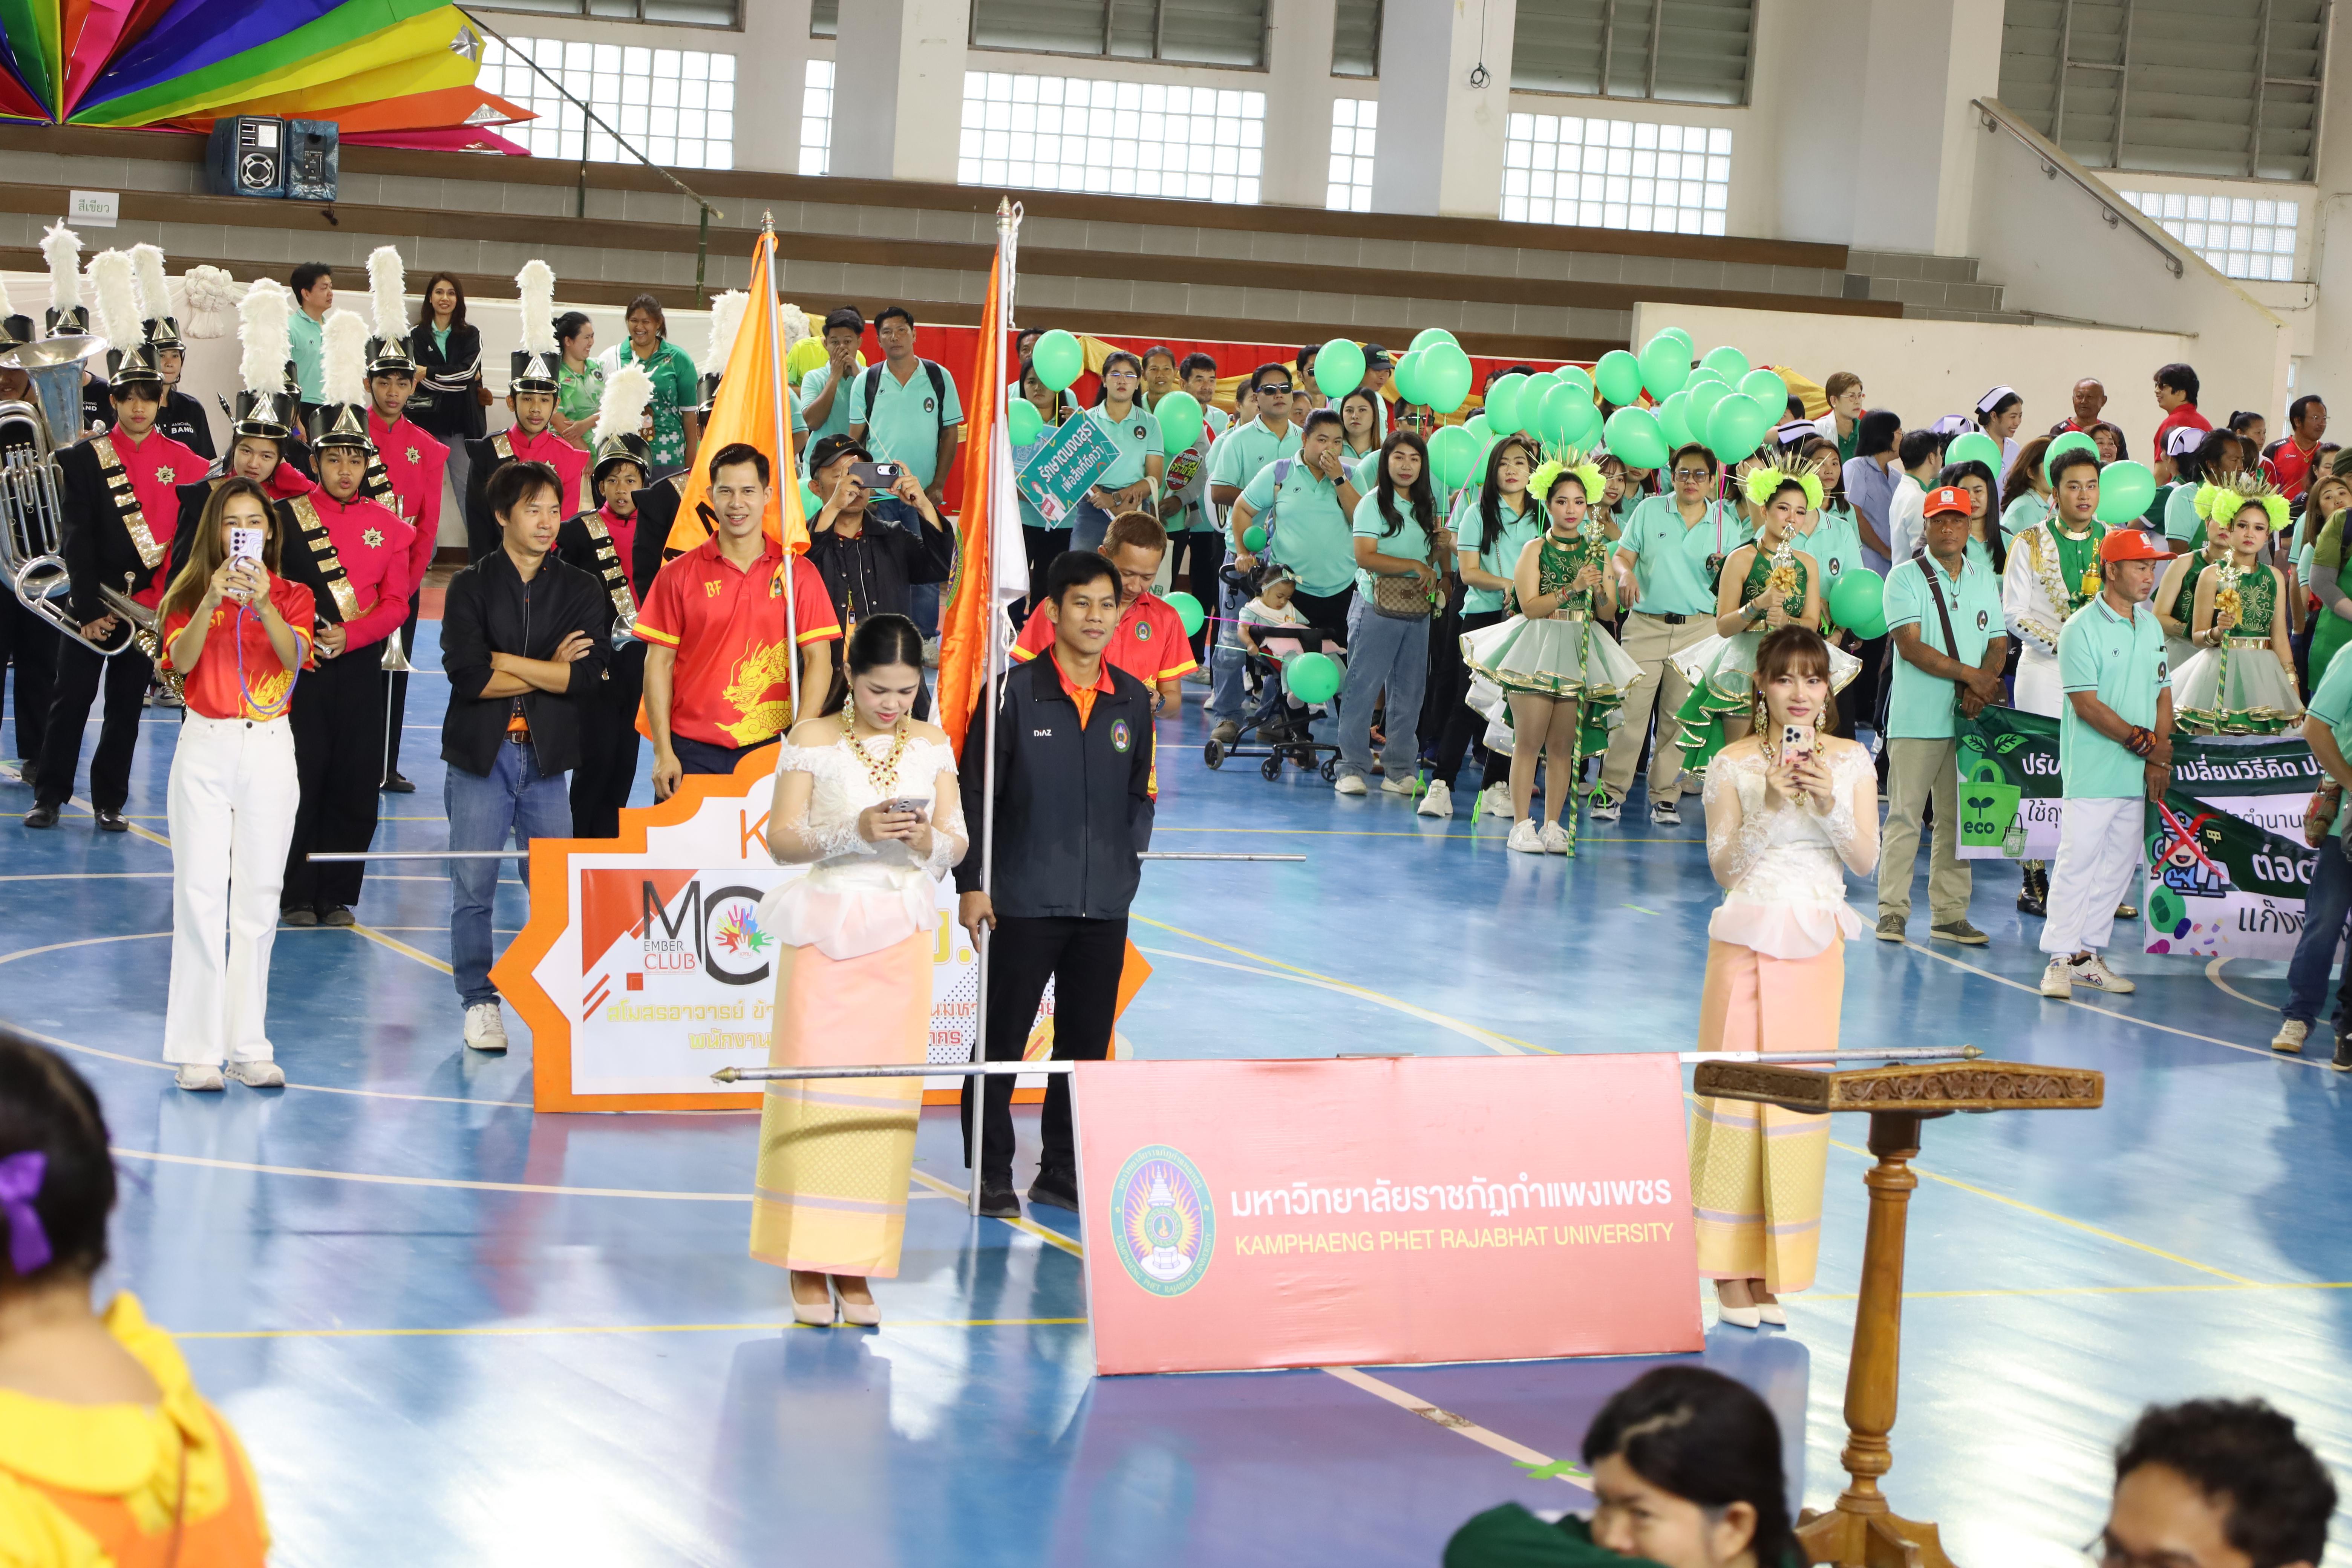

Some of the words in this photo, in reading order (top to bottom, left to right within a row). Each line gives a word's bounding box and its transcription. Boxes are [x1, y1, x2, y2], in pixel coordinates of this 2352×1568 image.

[78, 199, 109, 213] สีเขียว
[2176, 754, 2299, 781] เปลี่ยนวิธีคิด
[2028, 799, 2063, 829] ใช้ถุ
[1964, 821, 1995, 834] eco
[644, 953, 696, 970] CLUB
[607, 998, 745, 1021] สโมสรอาจารย์
[1231, 1171, 1672, 1217] มหาวิทยาลัยราชภัฏกำแพงเพชร
[1235, 1231, 1374, 1255] KAMPHAENG
[1380, 1230, 1434, 1251] PHET
[1441, 1226, 1548, 1249] RAJABHAT
[1554, 1222, 1674, 1245] UNIVERSITY
[1144, 1277, 1161, 1292] PHET
[1165, 1274, 1195, 1294] RAJABHAT
